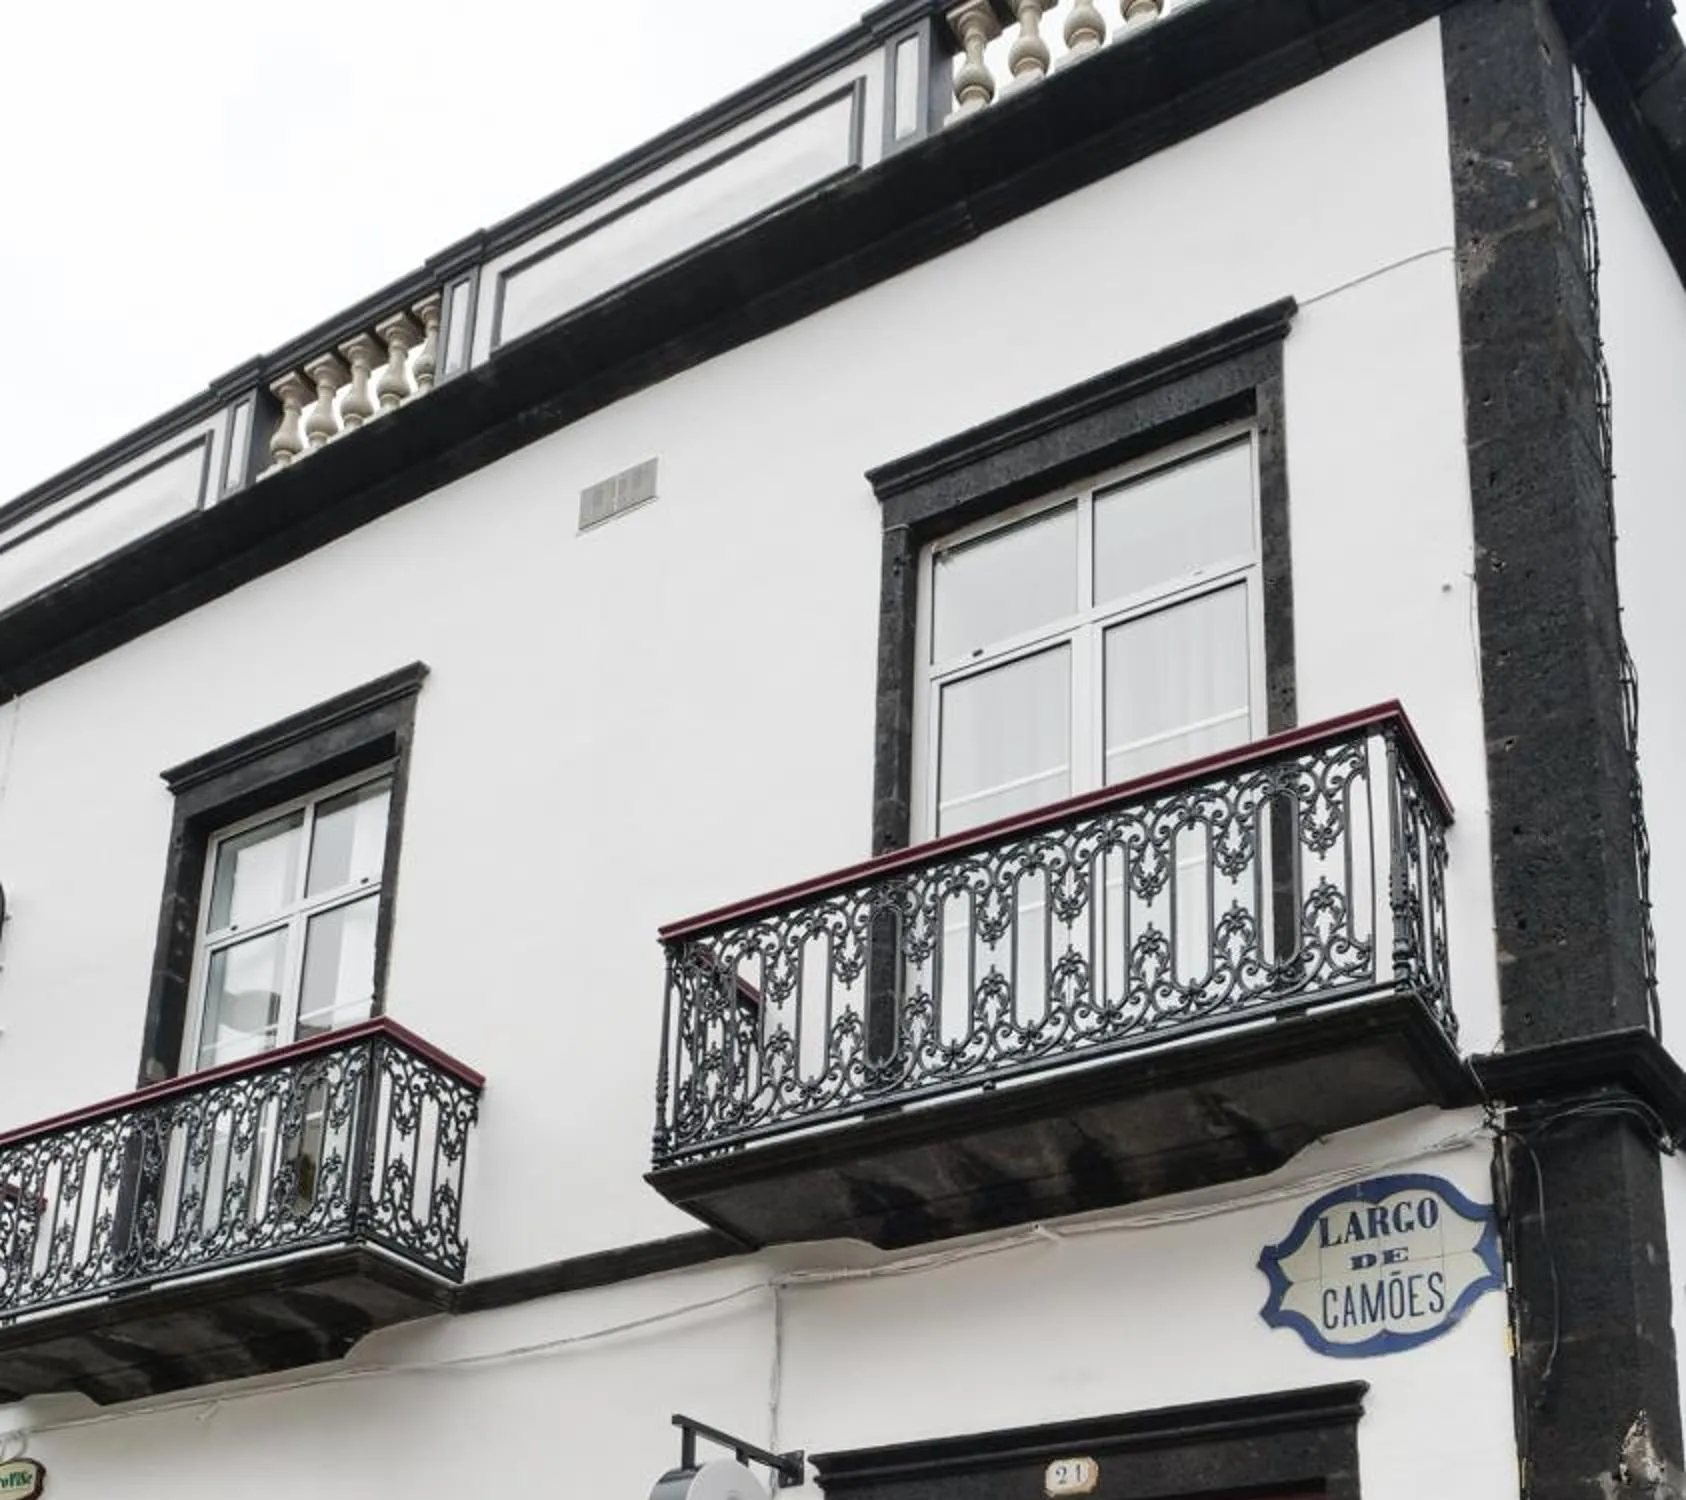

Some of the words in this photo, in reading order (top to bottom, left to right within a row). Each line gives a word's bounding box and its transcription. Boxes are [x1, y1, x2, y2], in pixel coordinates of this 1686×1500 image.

[1319, 1198, 1439, 1248] LARGO
[1350, 1248, 1409, 1270] DE
[1323, 1271, 1445, 1329] CAMÕES
[1055, 1463, 1082, 1485] 21
